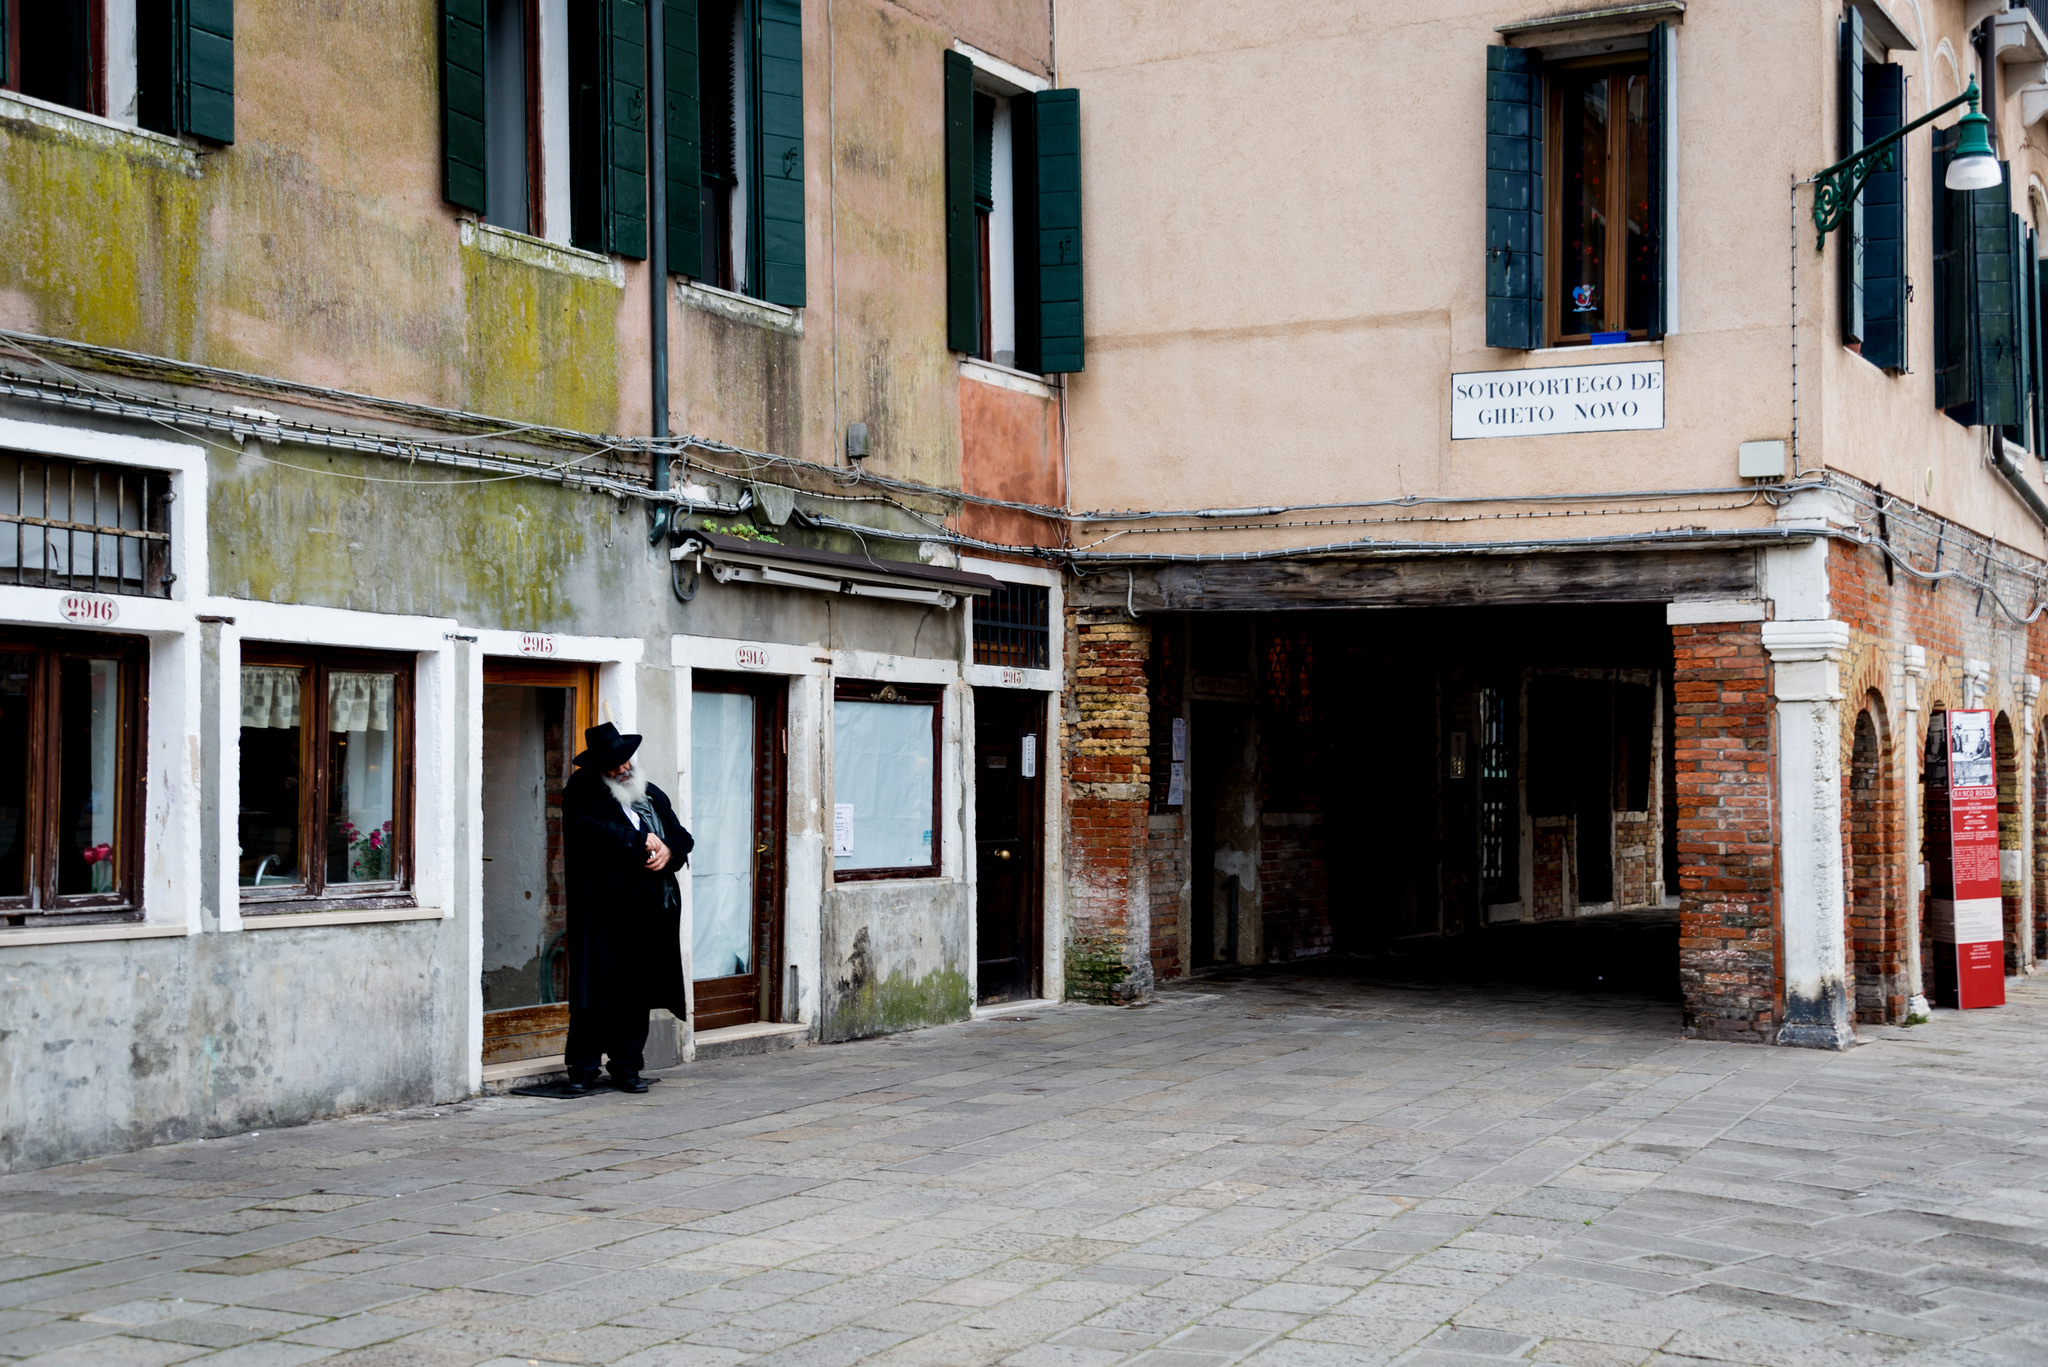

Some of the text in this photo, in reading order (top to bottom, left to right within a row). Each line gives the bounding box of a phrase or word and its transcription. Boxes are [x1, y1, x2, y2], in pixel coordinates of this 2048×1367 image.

[1456, 371, 1661, 400] SOTOPORTEGO DE
[1478, 400, 1638, 426] GHETO NOVO
[67, 598, 112, 620] 2916
[523, 635, 553, 653] 2915
[739, 649, 765, 665] 2914
[1953, 789, 1994, 798] BANCO ROSSO
